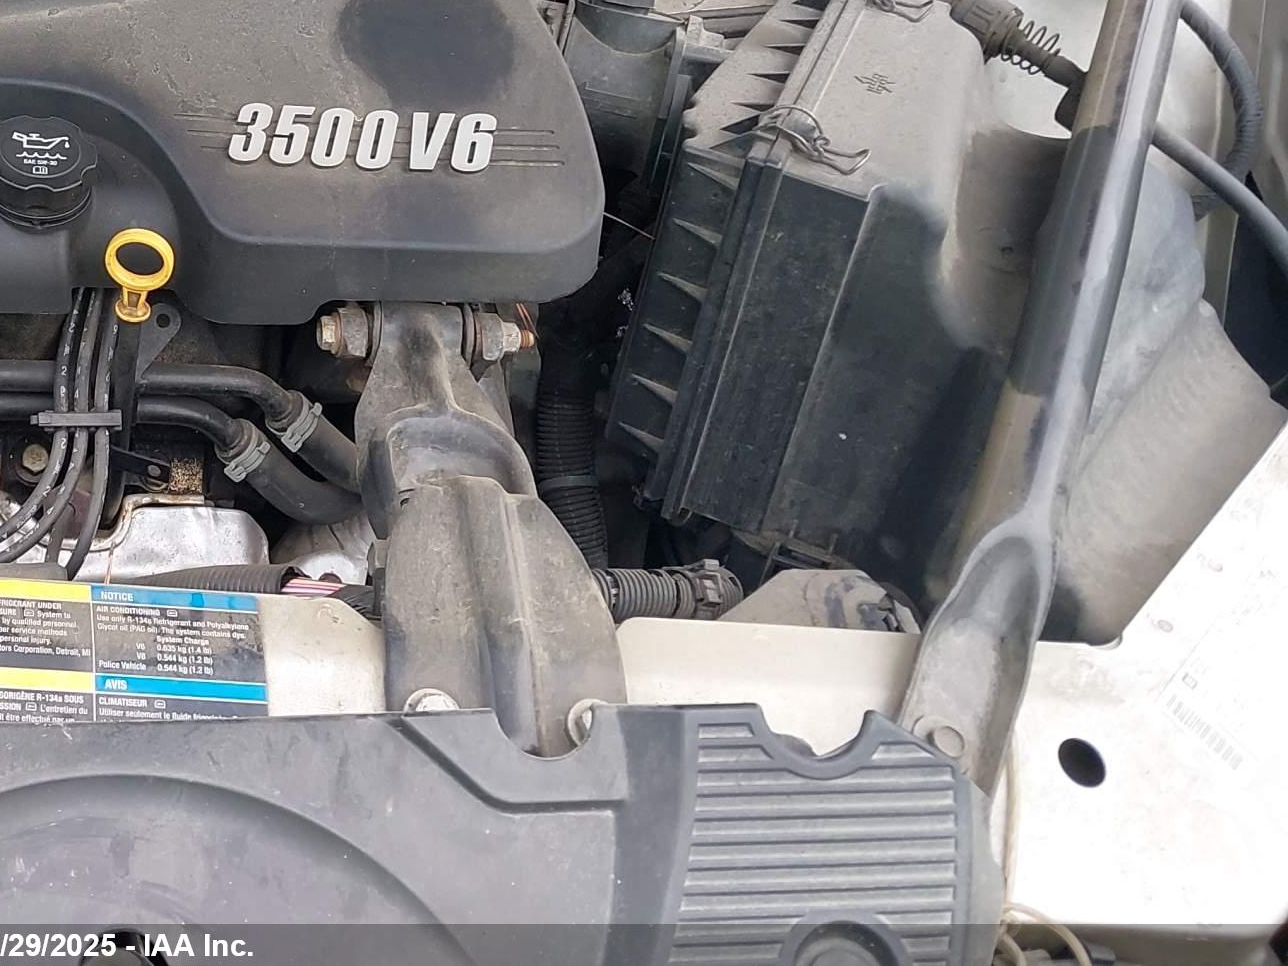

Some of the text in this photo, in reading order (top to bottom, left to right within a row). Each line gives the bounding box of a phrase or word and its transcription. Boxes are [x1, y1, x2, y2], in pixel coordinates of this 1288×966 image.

[227, 102, 498, 174] 3500 V6
[101, 591, 134, 602] NOTICE
[37, 611, 62, 619] System
[111, 607, 160, 616] CONDITIONING
[2, 617, 10, 625] by
[12, 618, 41, 626] qualified
[111, 616, 126, 624] only
[153, 619, 191, 628] Refrigerant
[97, 624, 118, 632] Glycol
[202, 630, 231, 638] contains
[0, 636, 29, 644] personal
[157, 636, 209, 646] System Charge
[14, 644, 54, 655] Corporation,
[178, 646, 186, 654] kg
[157, 654, 176, 662] 0.544
[178, 655, 187, 664] kg
[189, 656, 202, 664] (1.2
[204, 657, 213, 665] lb)
[99, 660, 120, 669] Police
[121, 662, 146, 671] Vehicle
[157, 665, 177, 673] 0.544
[179, 666, 187, 675] kg
[205, 667, 213, 675] lb)
[104, 679, 128, 690] AVIS
[36, 694, 63, 702] R-134a
[64, 695, 84, 704] SOUS
[99, 697, 147, 707] CLIMATISEUR
[40, 705, 77, 714] L'entretien
[79, 706, 88, 714] du
[99, 708, 124, 717] Utiliser
[126, 710, 162, 719] seulement
[6, 713, 20, 721] être
